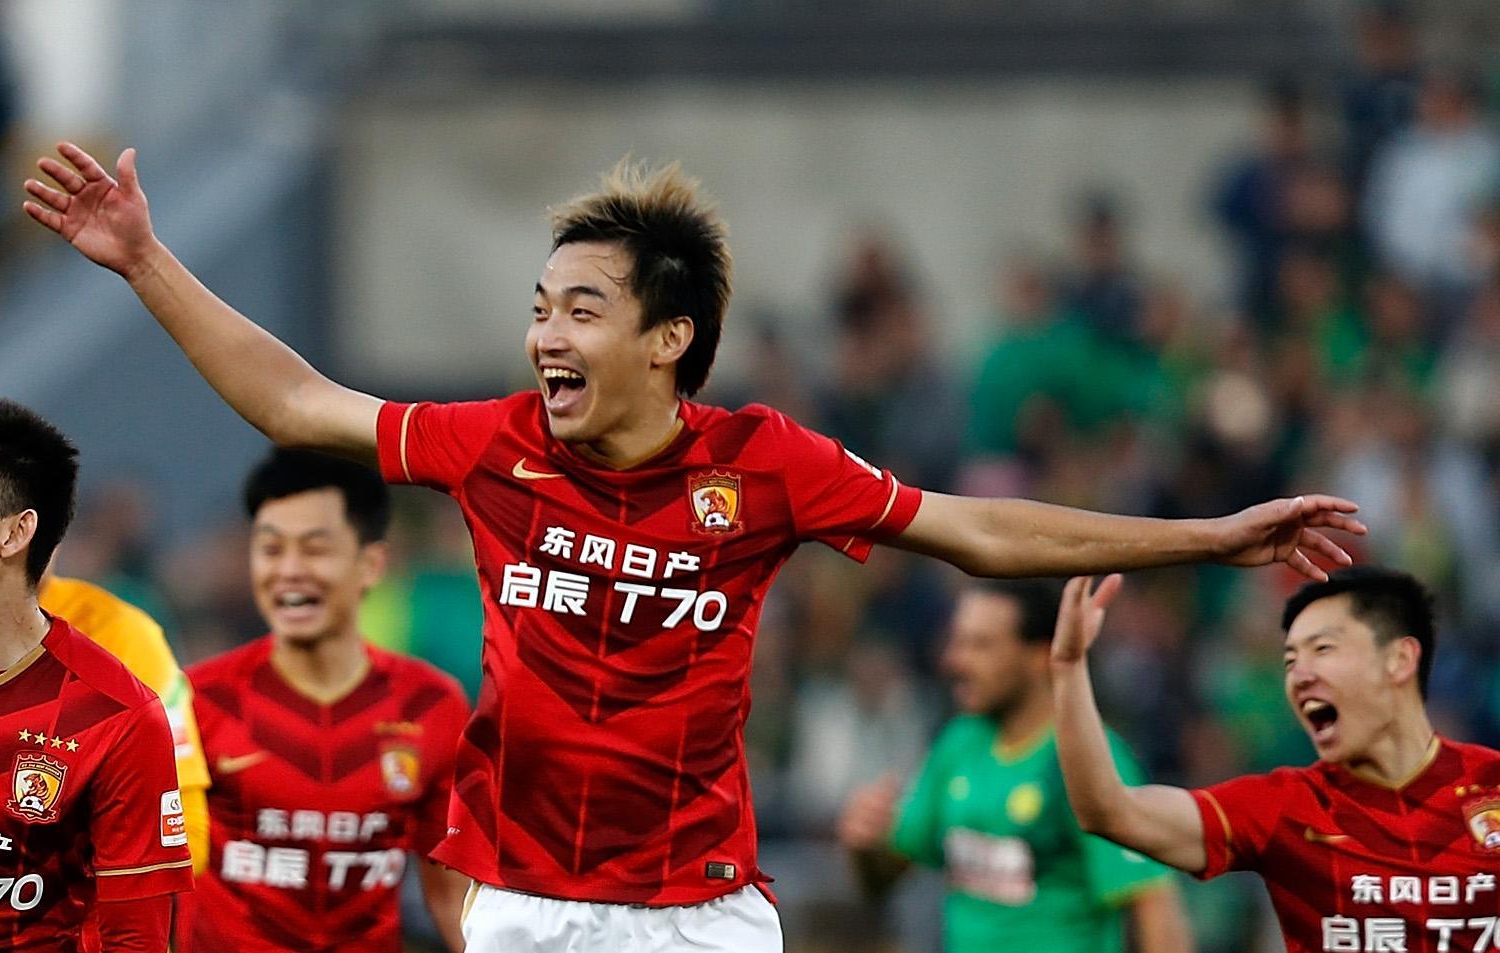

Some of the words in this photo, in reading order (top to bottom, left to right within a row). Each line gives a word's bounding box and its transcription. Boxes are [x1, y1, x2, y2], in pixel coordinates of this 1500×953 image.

[539, 527, 701, 579] 东风日产
[500, 562, 590, 616] 启辰
[613, 581, 727, 632] T70
[323, 847, 406, 893] T70
[1351, 873, 1496, 905] 东风日产
